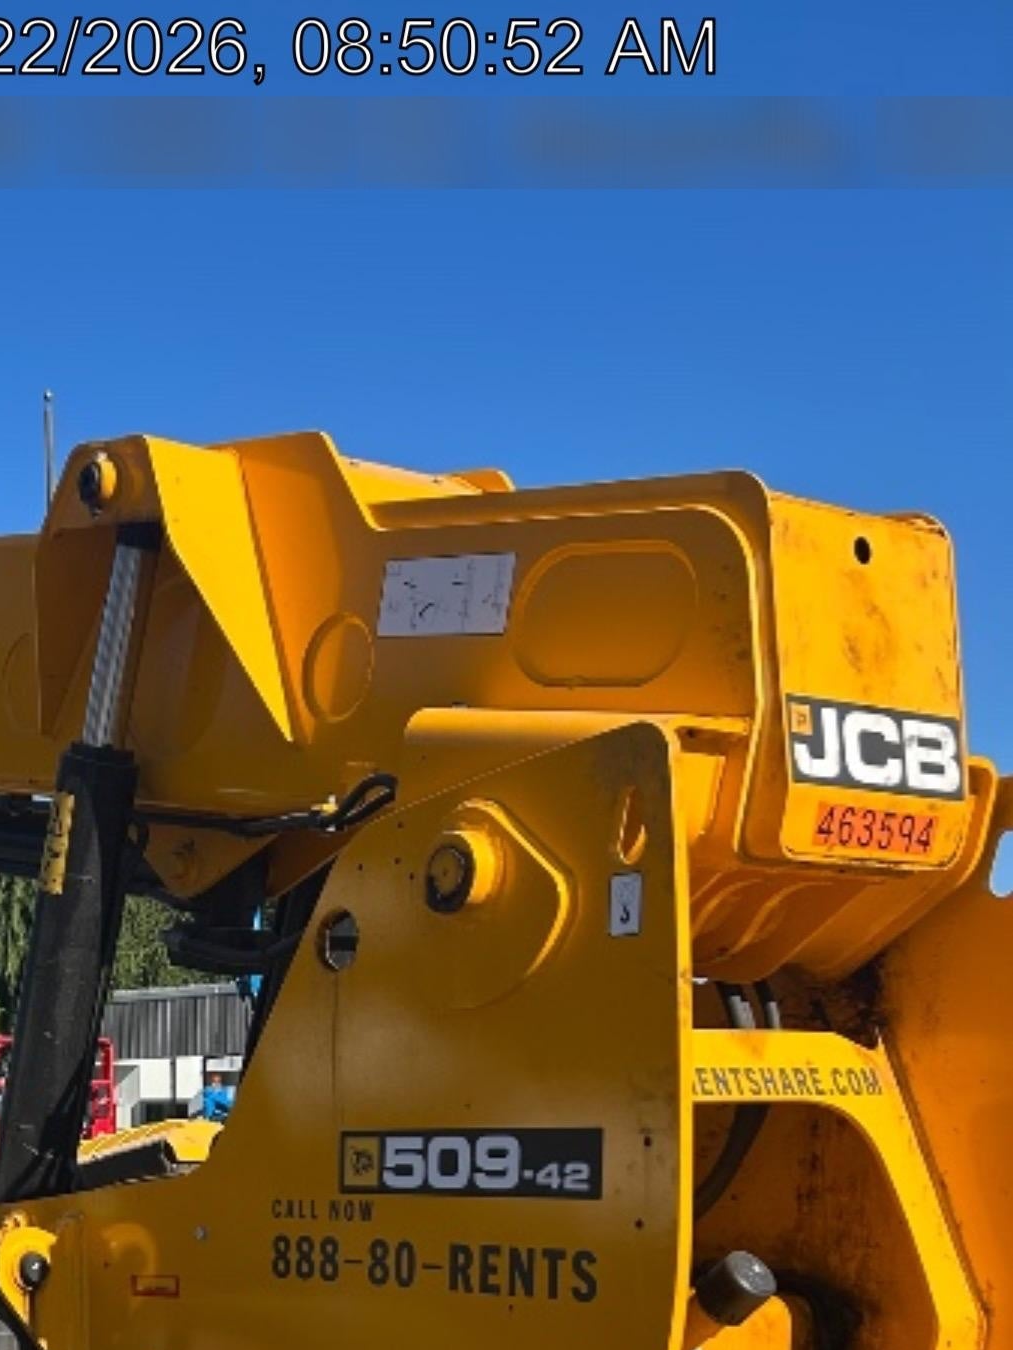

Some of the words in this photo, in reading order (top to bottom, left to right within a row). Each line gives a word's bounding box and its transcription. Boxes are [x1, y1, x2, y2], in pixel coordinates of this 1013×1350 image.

[793, 706, 961, 793] JCB
[815, 805, 935, 853] 463594
[271, 1200, 318, 1220] CALL
[328, 1200, 374, 1222] NOW
[271, 1234, 598, 1304] 888-80-RENTS
